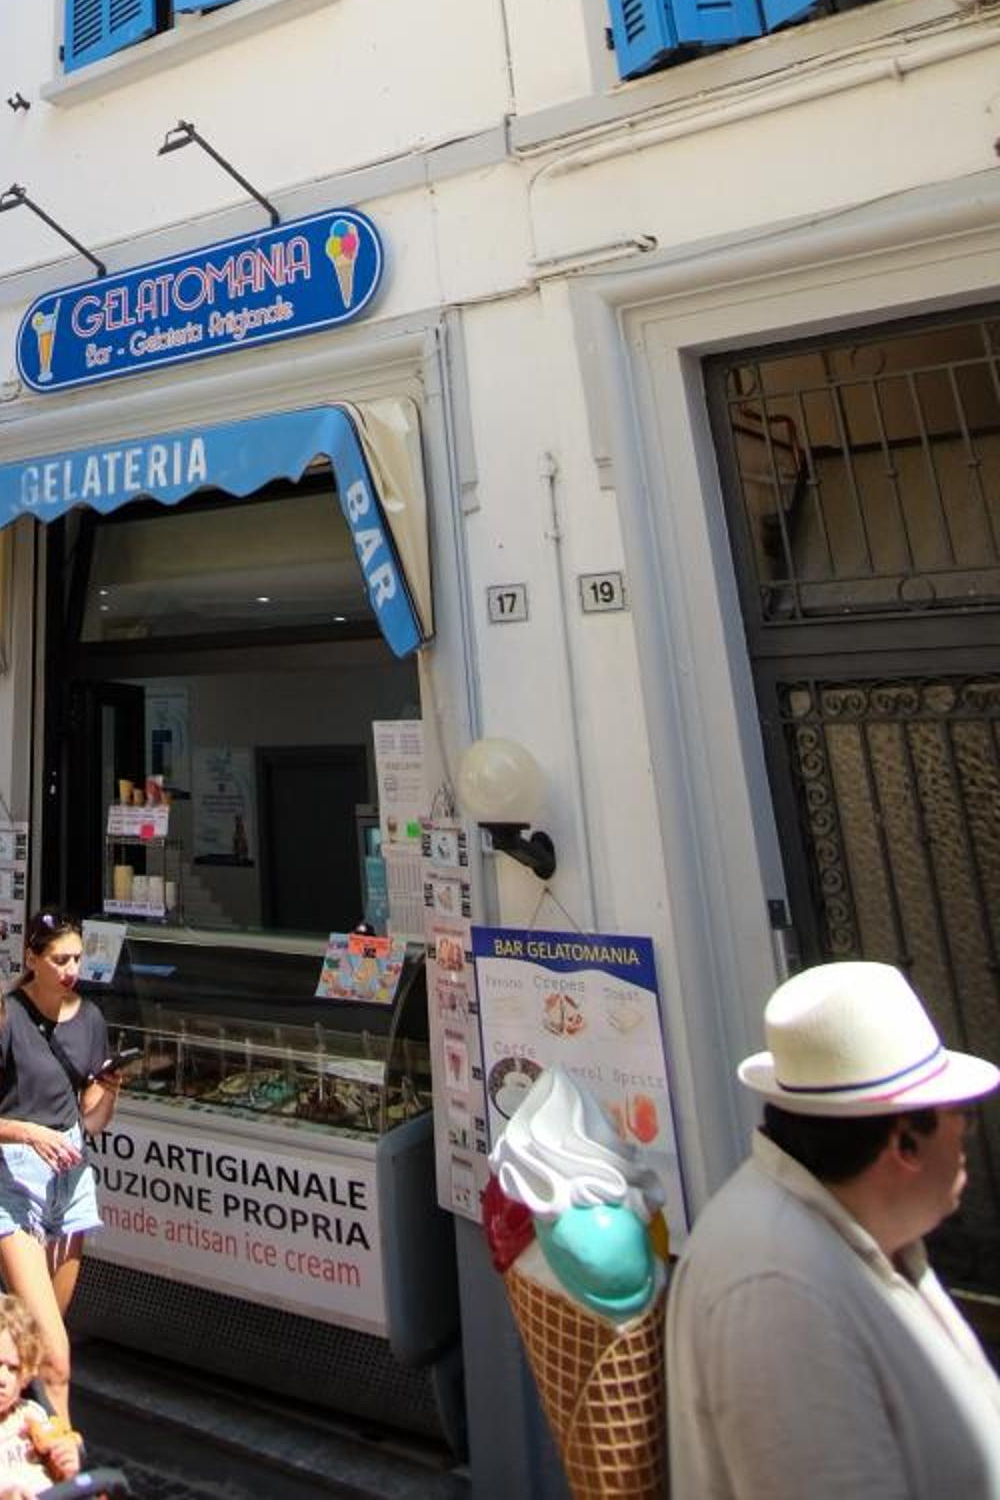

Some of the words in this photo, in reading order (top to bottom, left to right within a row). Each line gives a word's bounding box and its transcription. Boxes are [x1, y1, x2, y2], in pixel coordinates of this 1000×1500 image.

[71, 236, 311, 338] GELATOMANIA
[86, 343, 112, 367] Bar
[130, 322, 202, 357] Gelateria
[208, 295, 295, 340] Artigianale
[20, 437, 208, 506] GELATERIA
[347, 480, 396, 608] BAR
[497, 592, 517, 614] 17
[590, 580, 615, 604] 19
[494, 939, 523, 955] BAR
[527, 941, 640, 965] GELATOMANIA
[83, 1129, 135, 1159] ATO
[143, 1141, 368, 1210] ARTIGIANALE
[165, 1219, 238, 1256] artisan
[244, 1233, 277, 1265] ice
[285, 1249, 361, 1288] cream
[223, 1193, 371, 1251] PROPRIA
